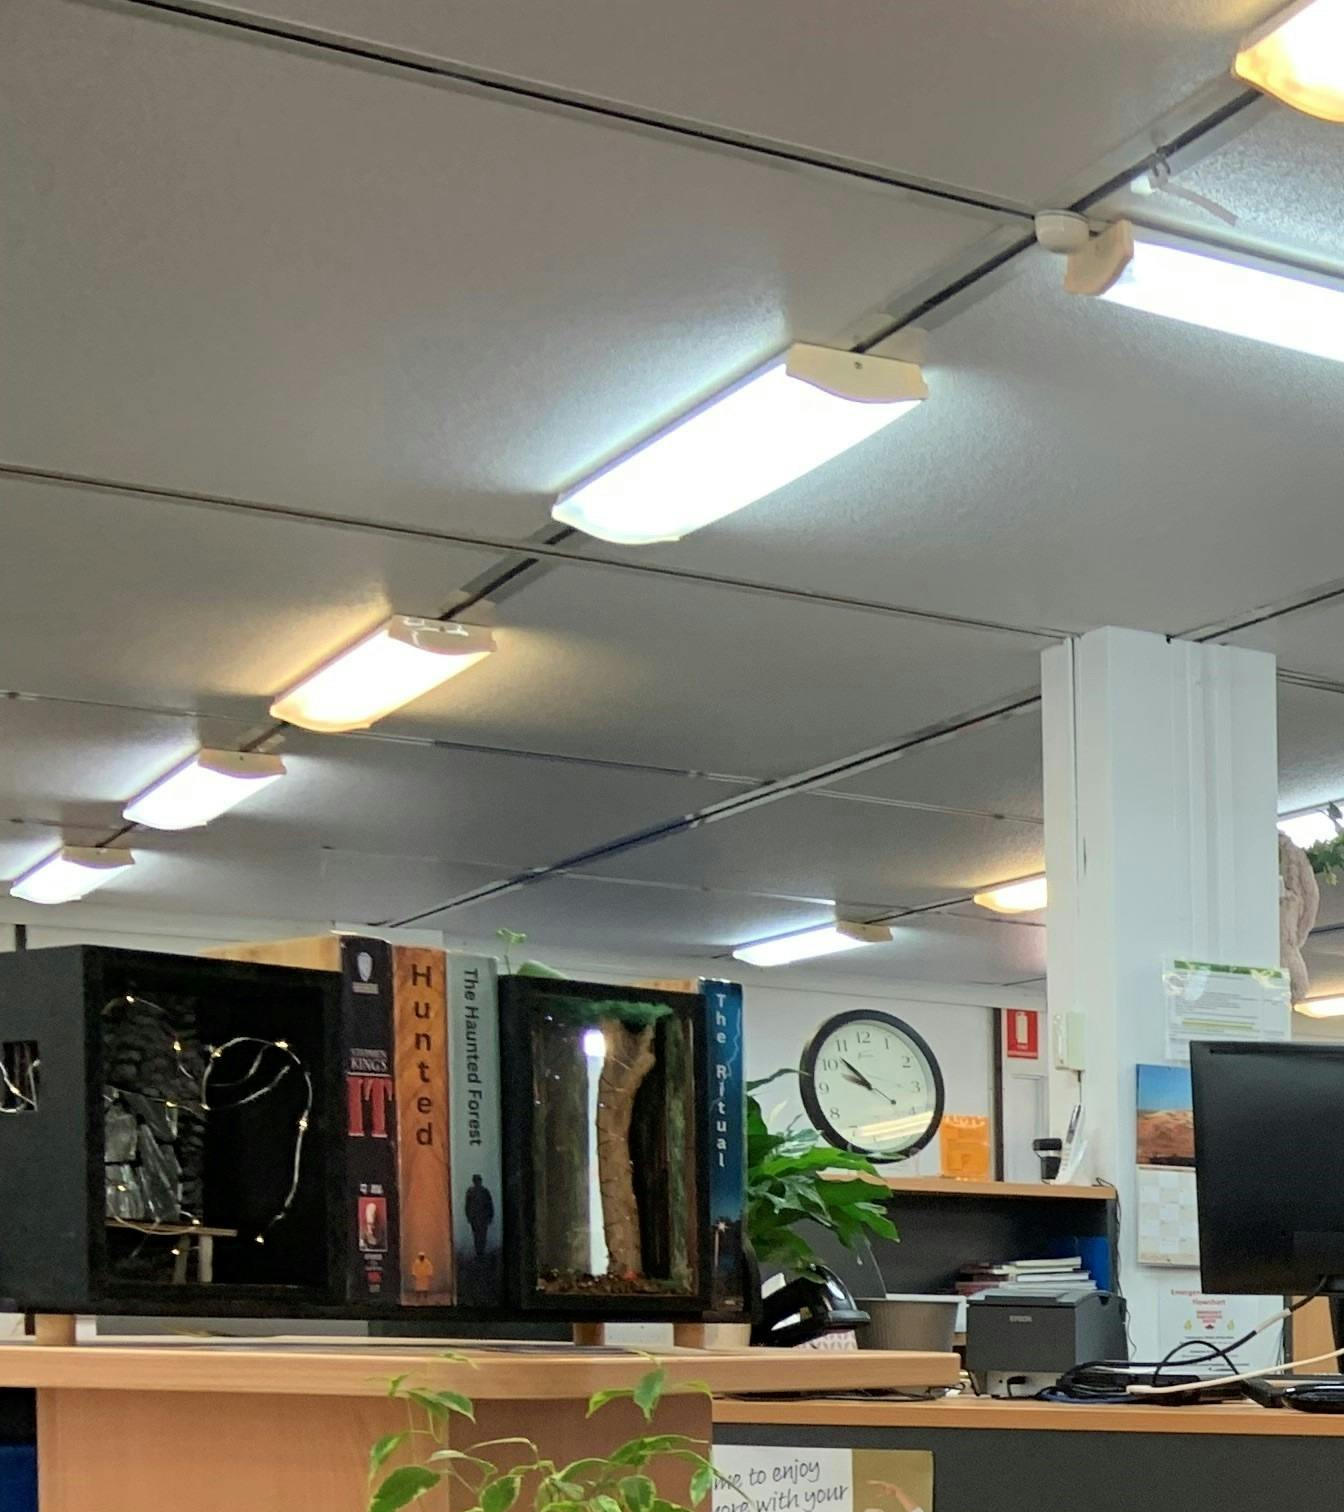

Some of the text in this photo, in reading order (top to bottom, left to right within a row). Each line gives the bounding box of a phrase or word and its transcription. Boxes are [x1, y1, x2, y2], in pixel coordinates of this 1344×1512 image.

[836, 1037, 890, 1052] 11 1
[856, 1031, 871, 1044] 12
[411, 963, 433, 1146] Hunted
[464, 968, 483, 1146] The Haunted Forest
[822, 1056, 911, 1072] 10 2
[715, 993, 728, 1168] The Ritual
[818, 1080, 921, 1095] 9 3
[346, 1075, 394, 1138] IT
[829, 1107, 841, 1119] 8
[750, 1459, 820, 1486] to enjoy
[802, 1484, 849, 1512] your
